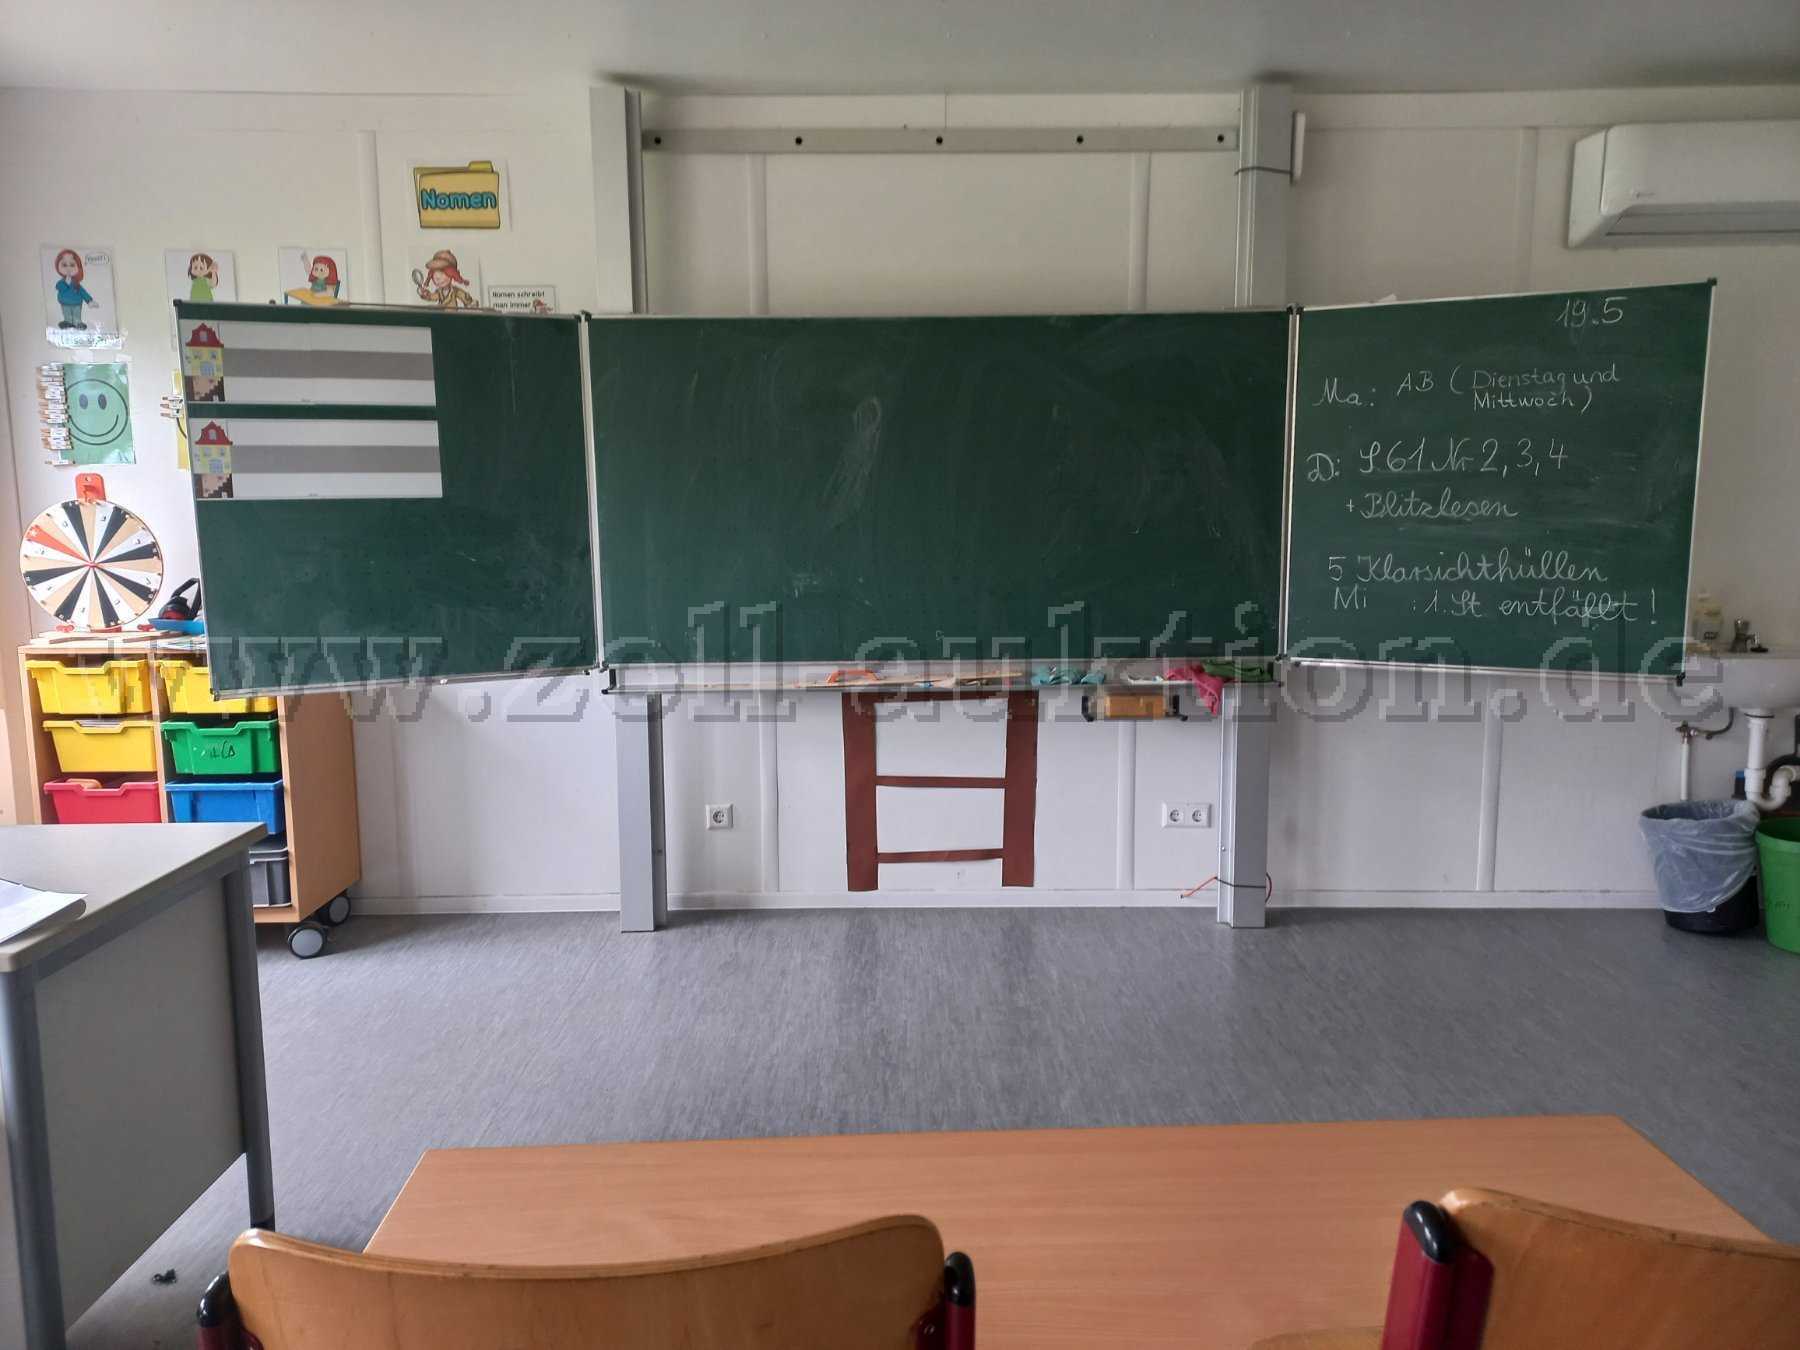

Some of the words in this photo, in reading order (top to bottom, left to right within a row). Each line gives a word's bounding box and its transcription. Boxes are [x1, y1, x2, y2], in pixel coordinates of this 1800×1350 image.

[420, 187, 498, 210] Nomen
[1555, 296, 1628, 328] 19.5
[1312, 376, 1377, 407] Ma:
[1396, 370, 1435, 396] AB
[1572, 362, 1622, 385] und
[1305, 451, 1341, 482] D:
[1327, 554, 1348, 582] 5
[1356, 546, 1609, 584] Klarsichthüllen
[1332, 583, 1369, 611] Mi
